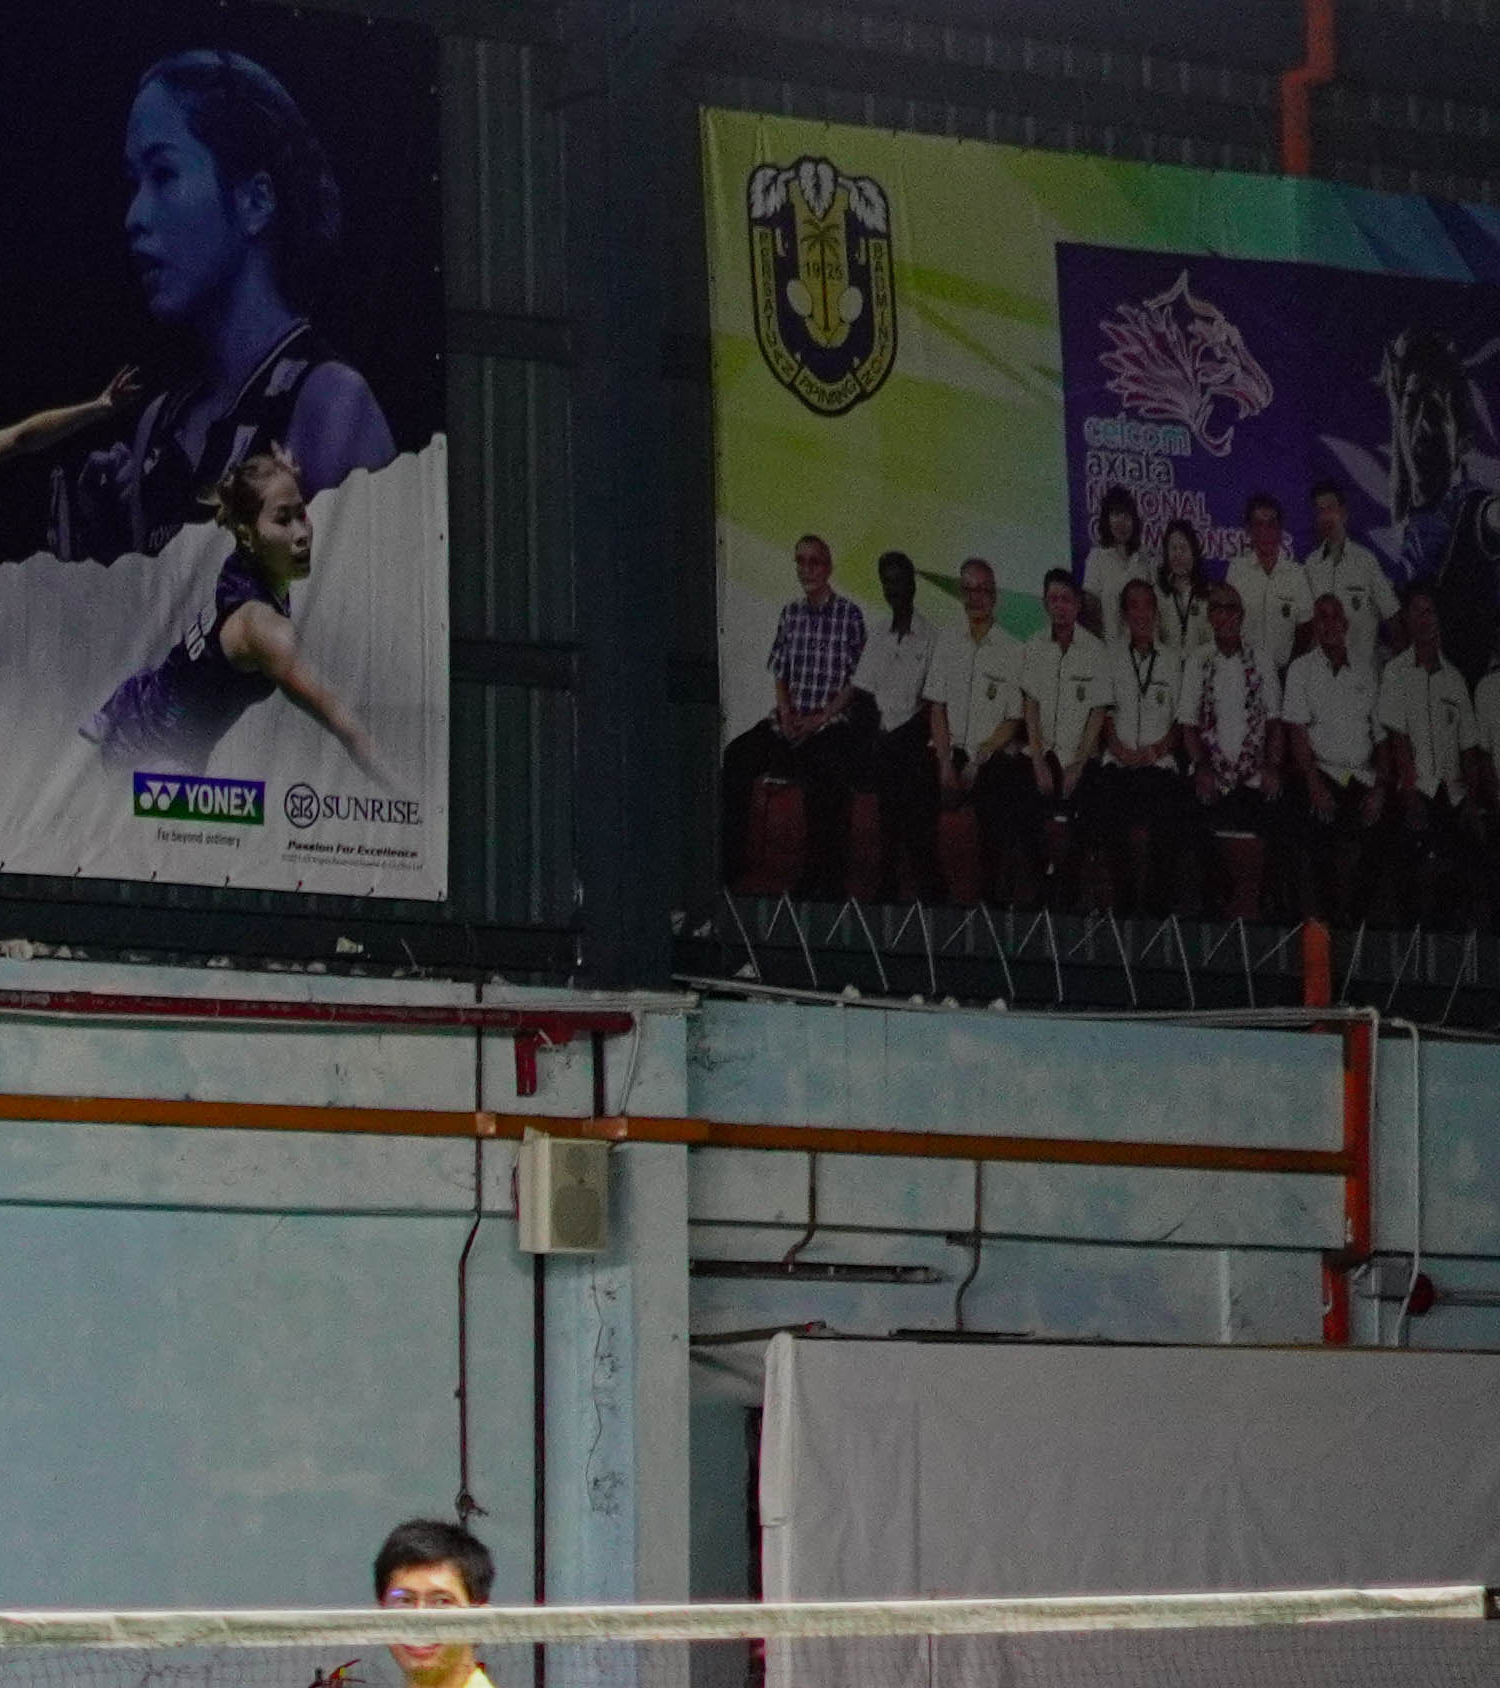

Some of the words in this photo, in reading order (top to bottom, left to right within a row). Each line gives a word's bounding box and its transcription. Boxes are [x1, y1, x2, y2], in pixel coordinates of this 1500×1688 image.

[185, 783, 258, 818] YONEX
[321, 795, 420, 825] SUNRISE
[287, 840, 334, 853] Passion
[357, 845, 418, 858] Excellence
